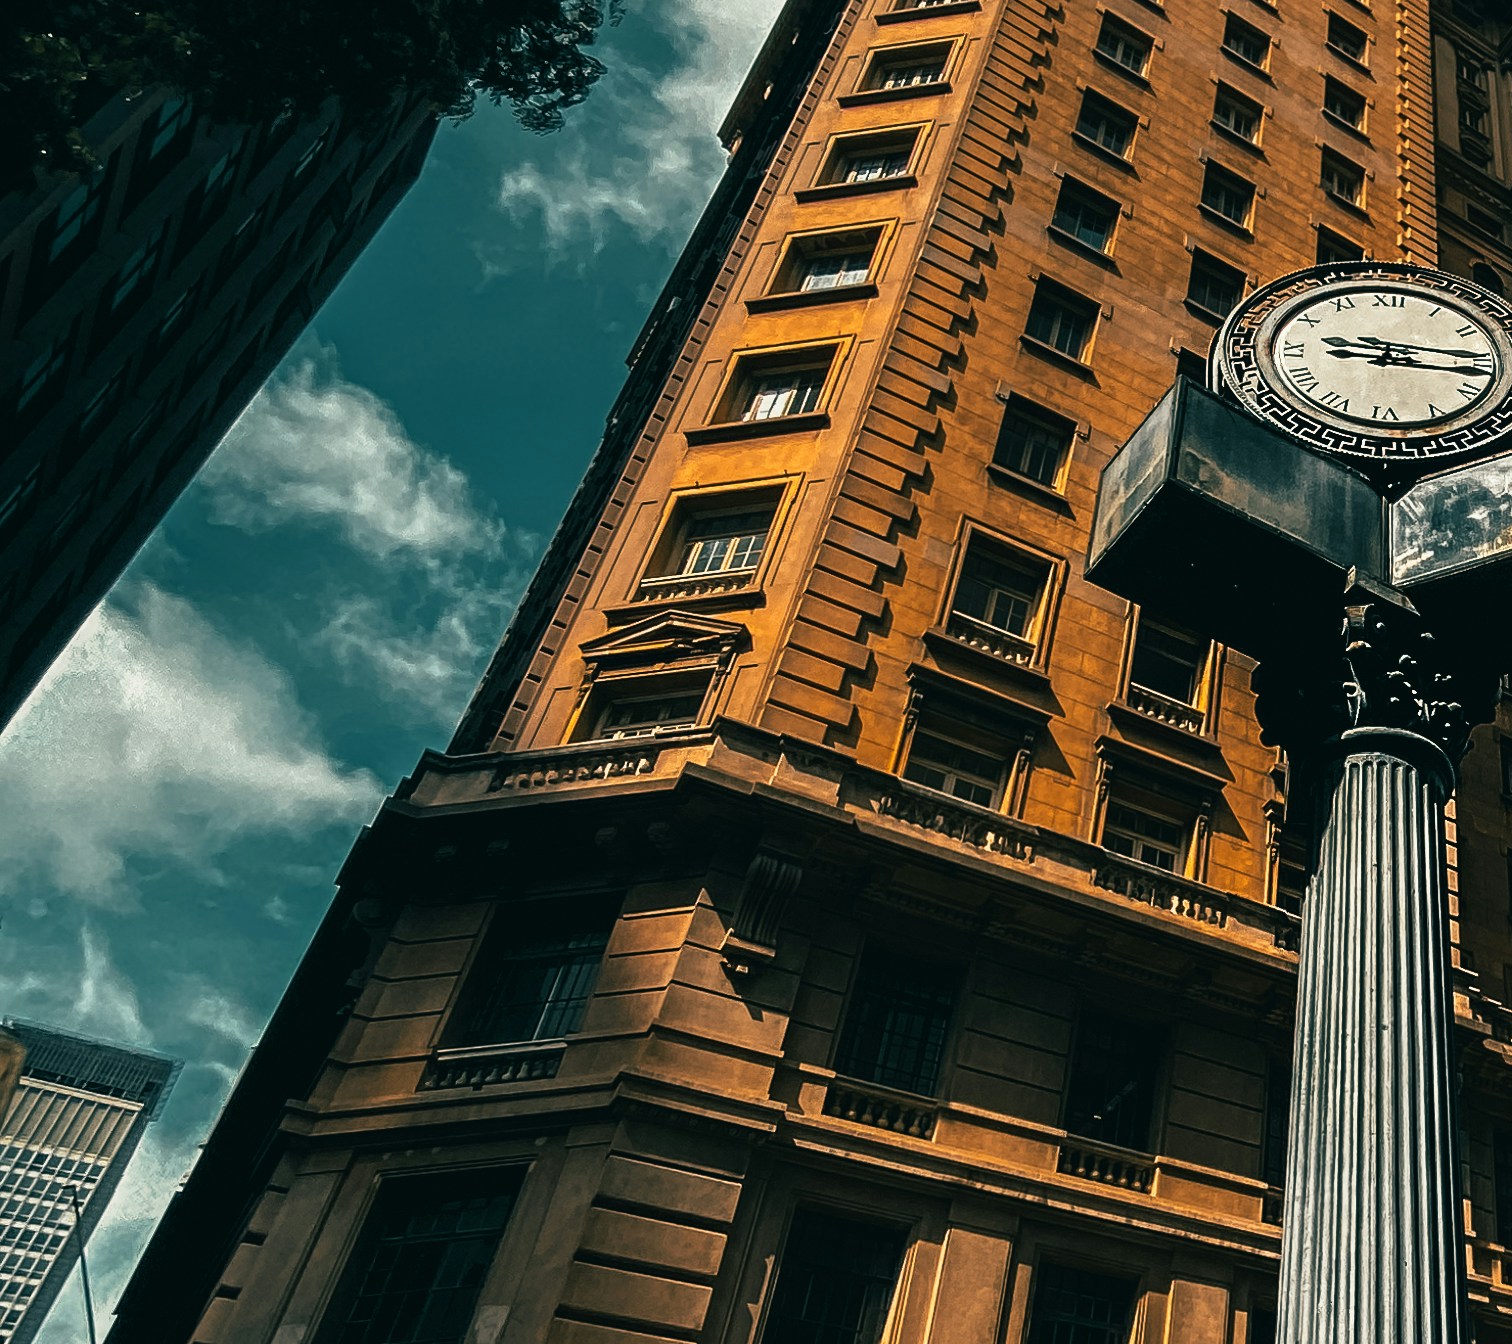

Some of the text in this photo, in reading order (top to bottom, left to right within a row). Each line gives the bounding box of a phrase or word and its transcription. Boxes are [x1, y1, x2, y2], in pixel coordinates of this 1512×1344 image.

[1329, 296, 1355, 312] XI
[1372, 294, 1406, 308] XII
[1428, 307, 1442, 317] I
[1297, 313, 1321, 328] X
[1455, 324, 1478, 338] II
[1284, 340, 1304, 358] IX
[1289, 367, 1320, 393] VIII
[1456, 382, 1482, 401] IV
[1319, 391, 1350, 413] VII
[1371, 405, 1400, 421] VI
[1427, 403, 1446, 418] V
